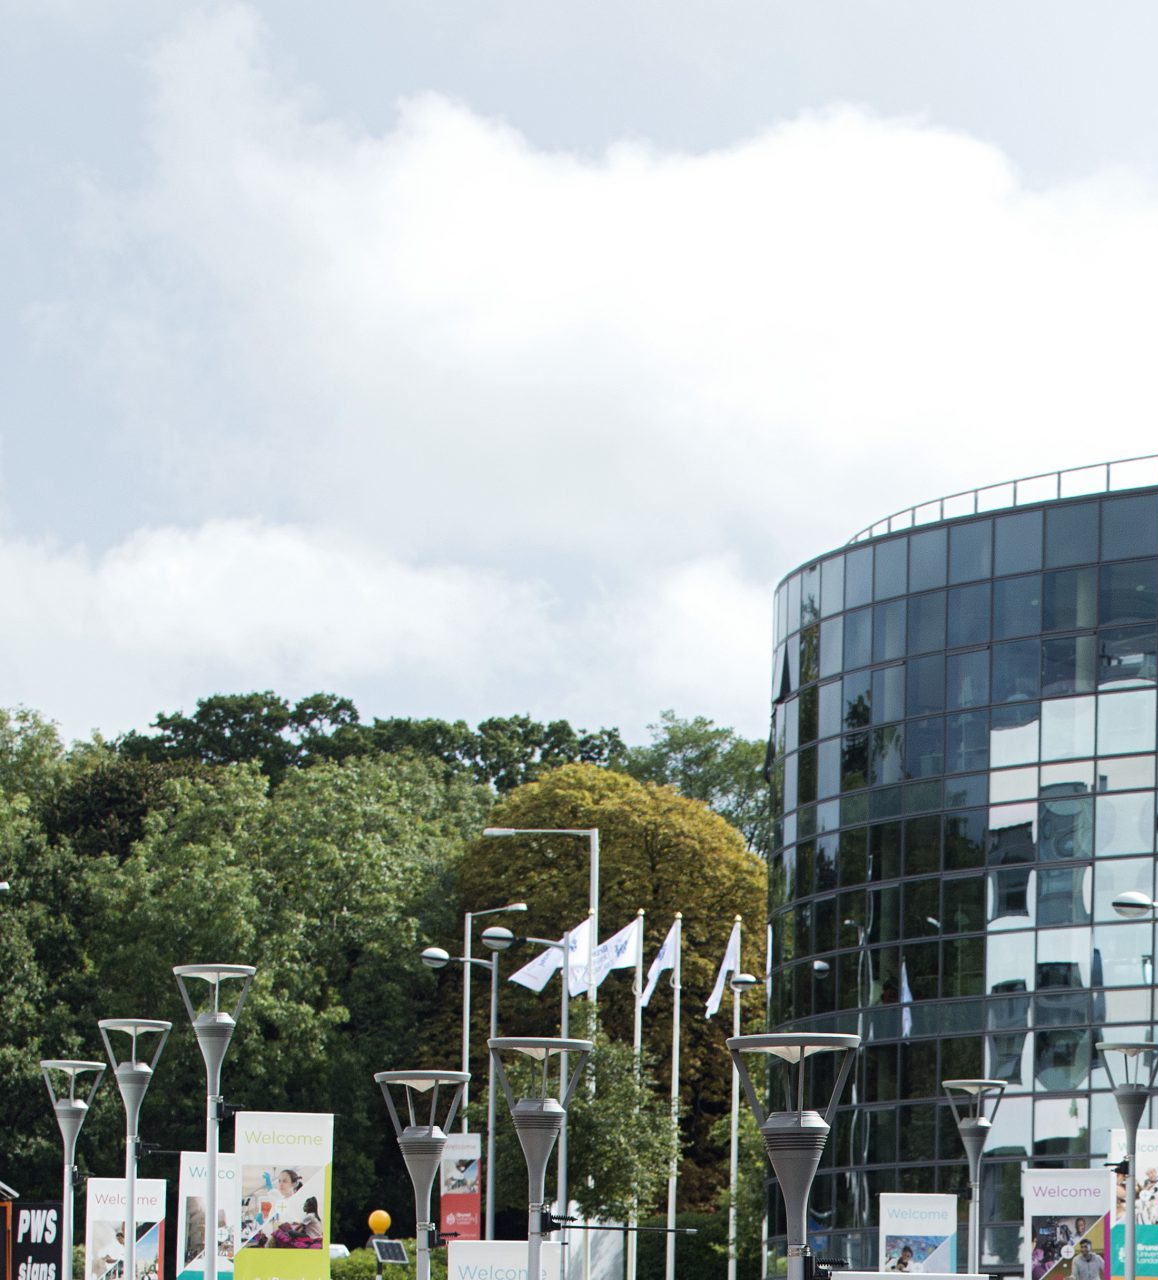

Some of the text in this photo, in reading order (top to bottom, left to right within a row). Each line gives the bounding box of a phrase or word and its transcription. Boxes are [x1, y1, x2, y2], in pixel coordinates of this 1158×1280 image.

[245, 1131, 323, 1145] Welcome
[1033, 1186, 1101, 1198] Welcome
[95, 1193, 158, 1206] Welcme
[887, 1207, 948, 1220] Welcome
[17, 1208, 58, 1244] PWS
